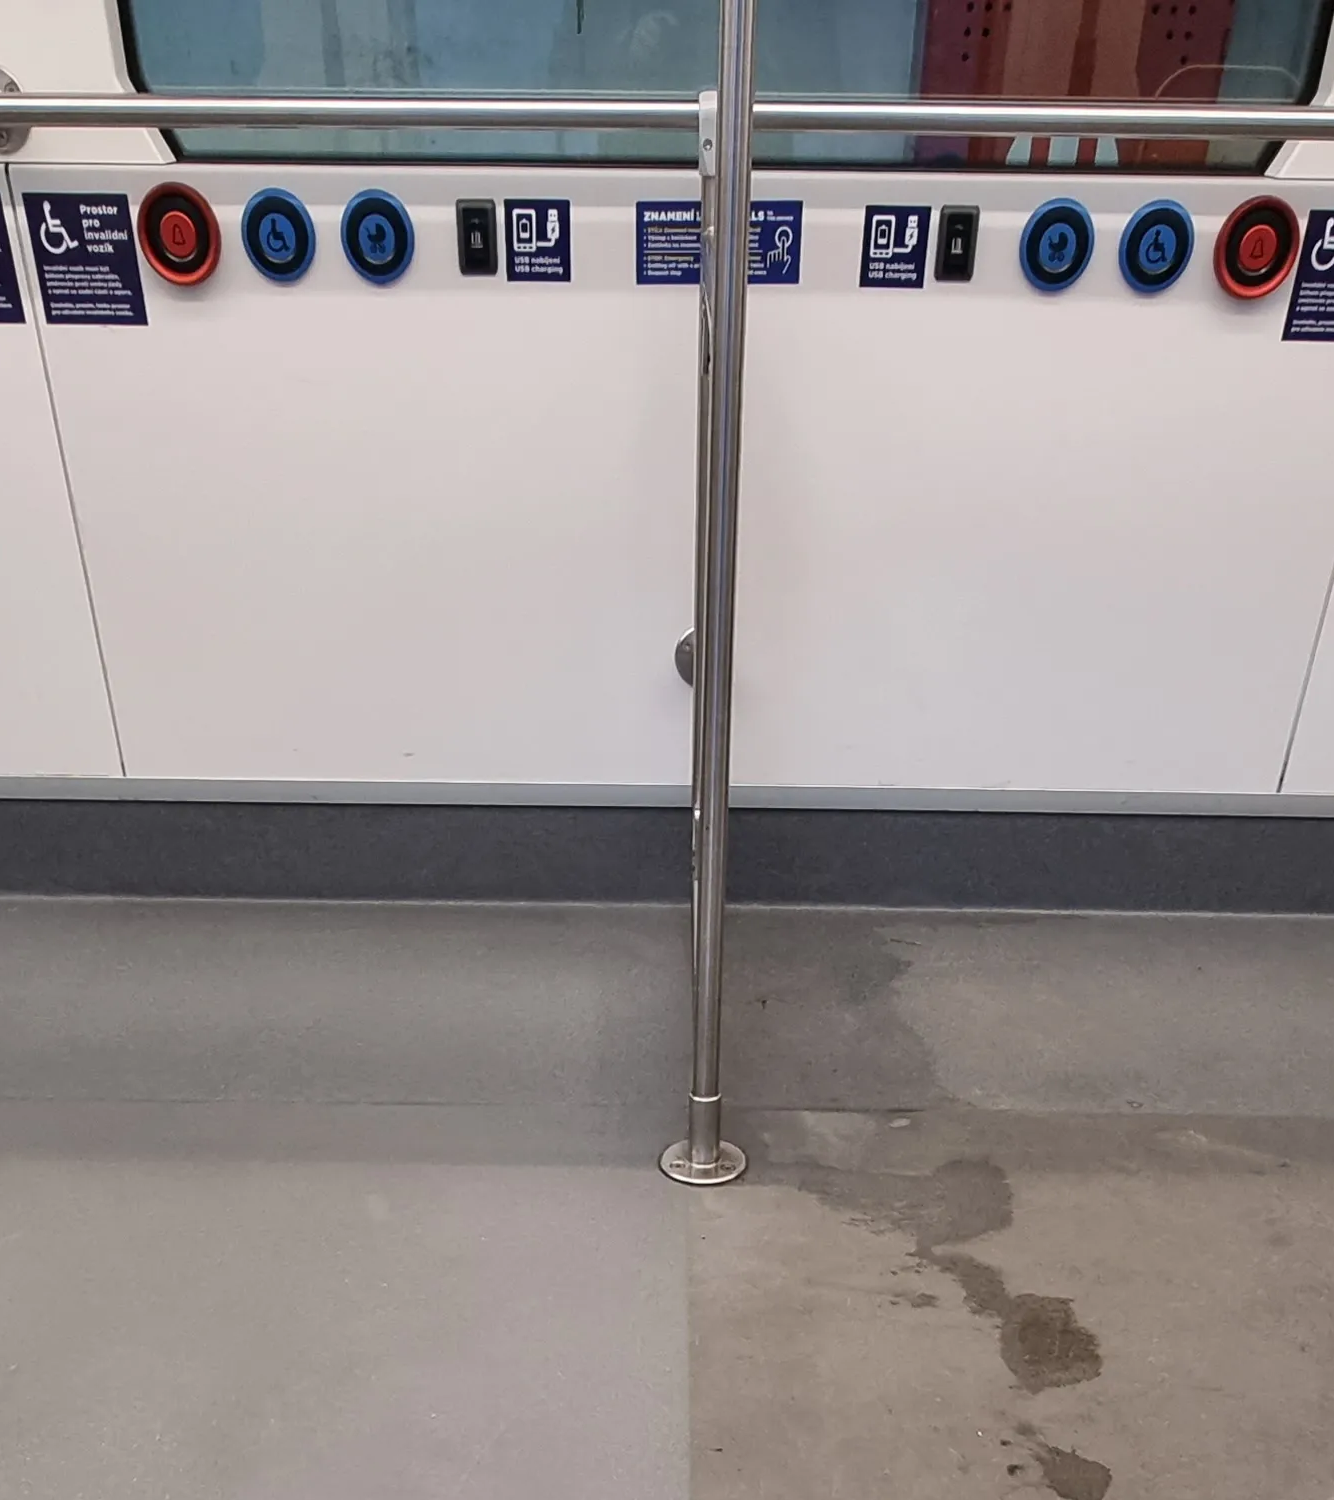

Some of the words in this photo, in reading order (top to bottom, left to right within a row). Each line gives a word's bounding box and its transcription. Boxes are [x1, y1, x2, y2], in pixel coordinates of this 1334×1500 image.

[79, 204, 118, 215] Prostor
[643, 208, 695, 222] ZNAMENÍ
[82, 219, 101, 229] pro
[84, 228, 128, 240] invalidní
[87, 242, 114, 253] vozík
[514, 256, 530, 264] USB
[869, 261, 884, 270] USB
[515, 265, 530, 273] USB
[531, 265, 563, 275] charging
[868, 270, 883, 279] USB
[885, 271, 917, 281] charging
